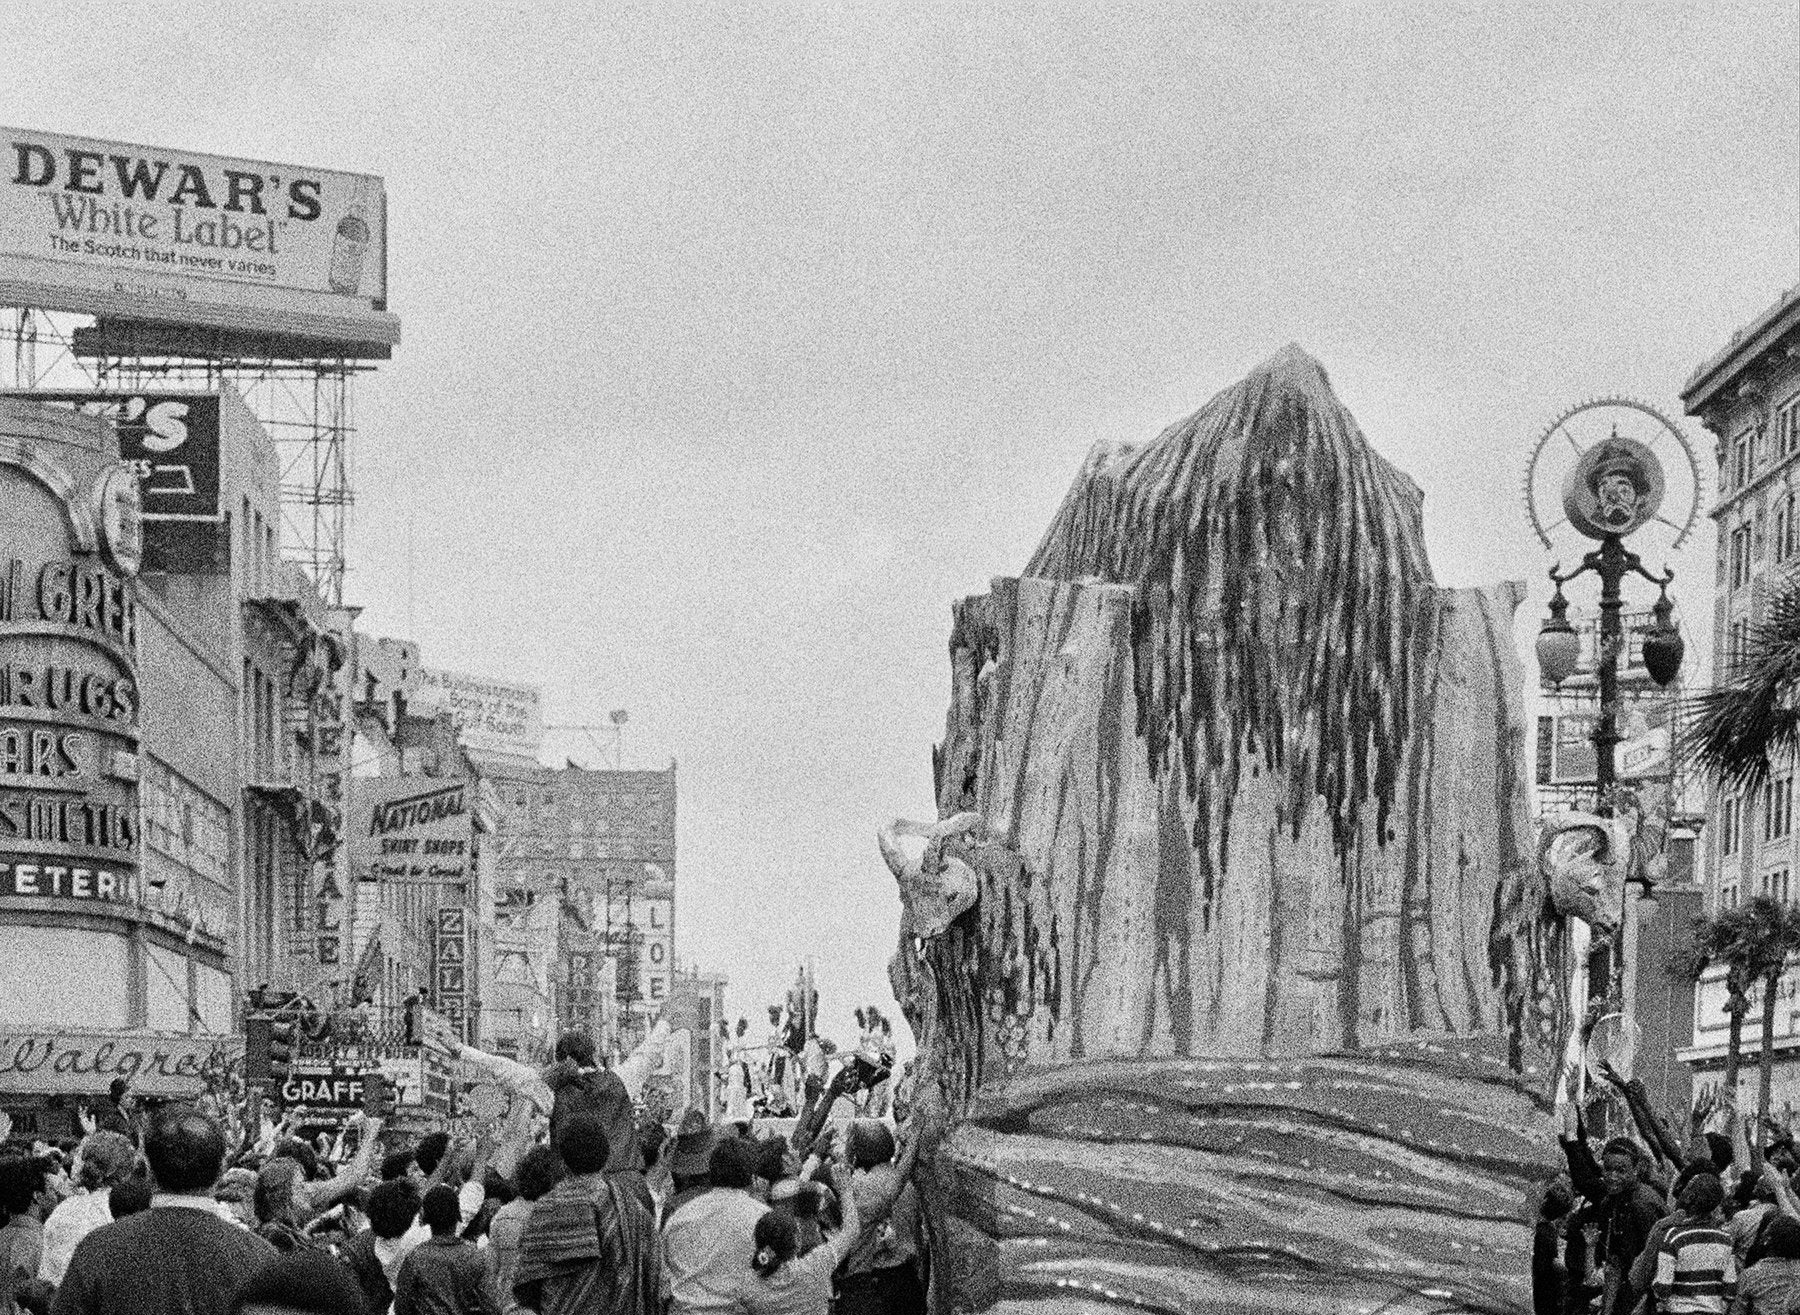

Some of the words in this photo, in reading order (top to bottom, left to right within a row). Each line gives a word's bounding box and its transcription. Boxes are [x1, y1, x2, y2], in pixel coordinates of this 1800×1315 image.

[12, 141, 322, 221] DEWAR'S
[49, 234, 79, 254] The
[84, 238, 142, 262] Scotch
[144, 248, 176, 266] that
[179, 253, 224, 270] never
[228, 257, 276, 276] varies
[0, 660, 137, 723] RUGS
[369, 784, 466, 838] NATIONAL
[381, 838, 419, 856] SHIRT
[422, 838, 466, 856] SHOPS
[281, 1079, 366, 1103] GRAFF
